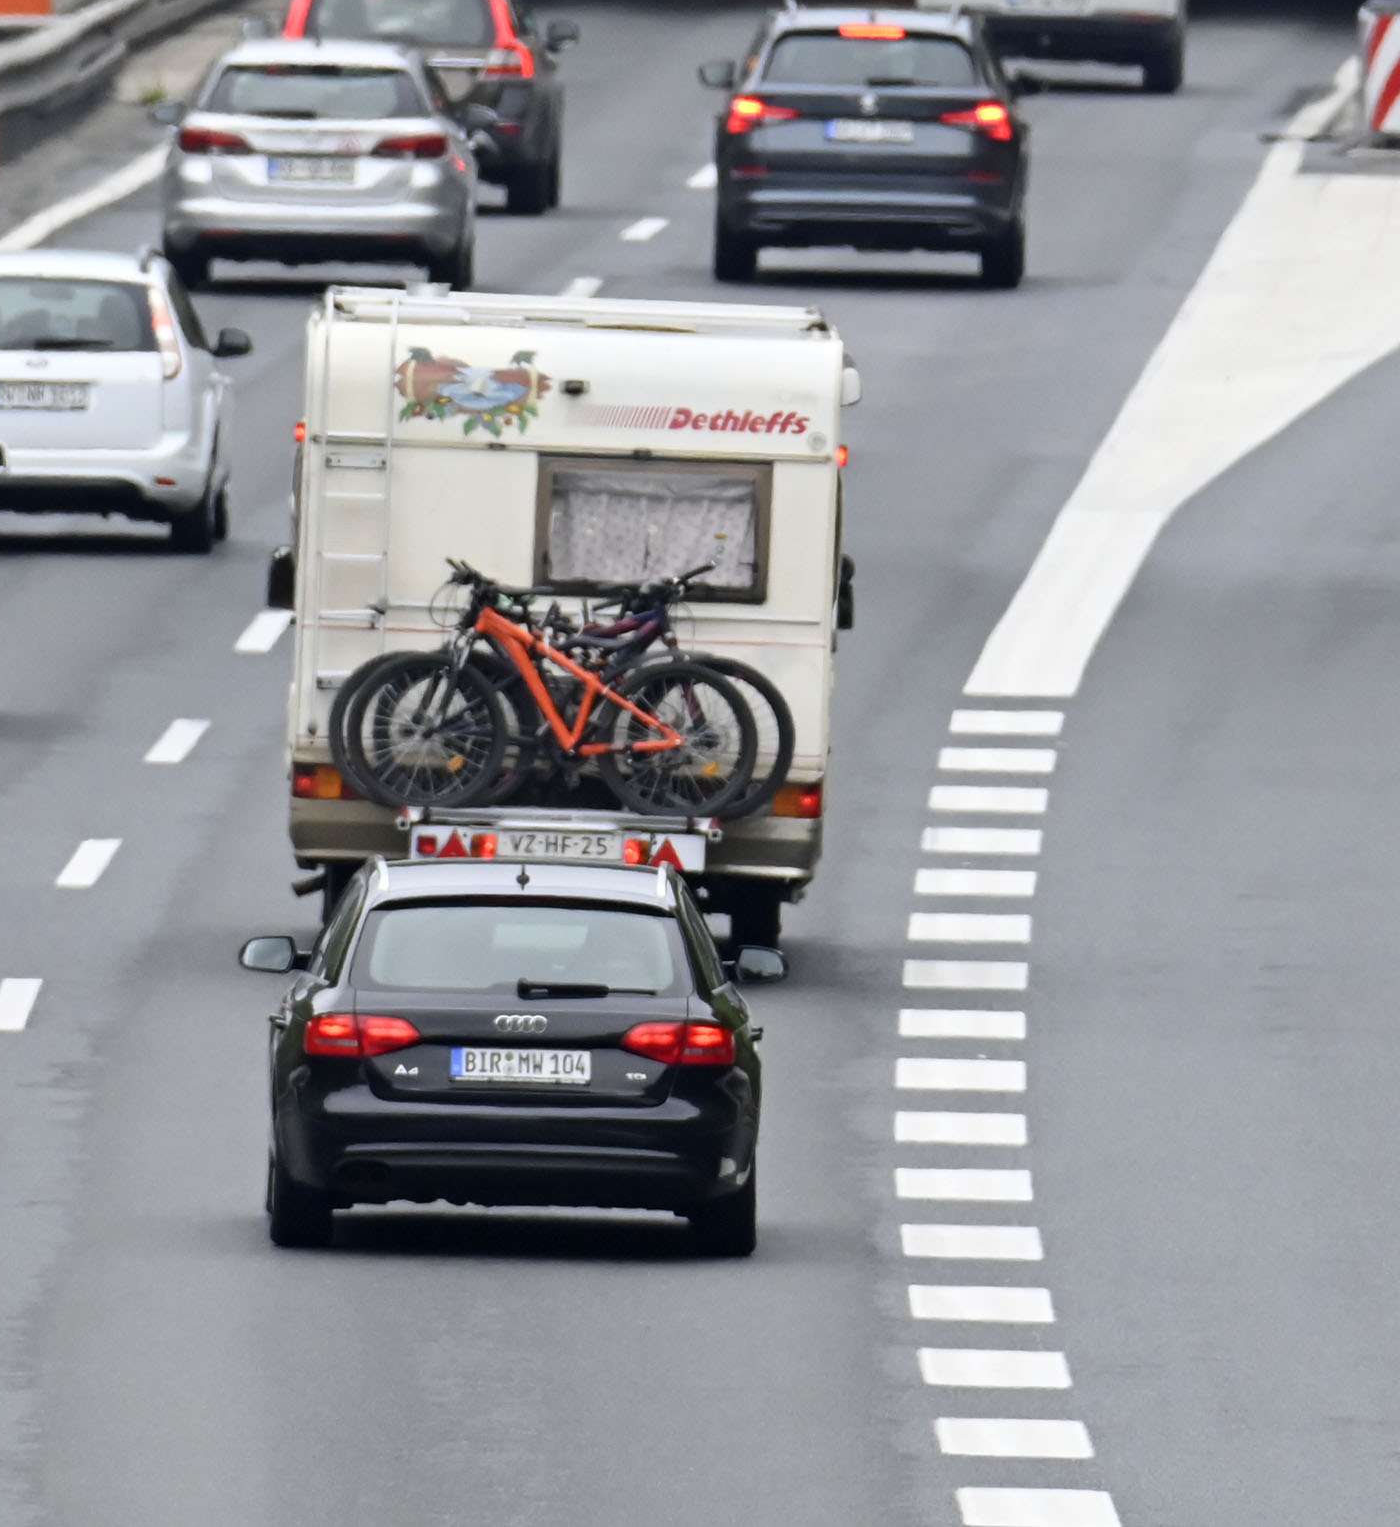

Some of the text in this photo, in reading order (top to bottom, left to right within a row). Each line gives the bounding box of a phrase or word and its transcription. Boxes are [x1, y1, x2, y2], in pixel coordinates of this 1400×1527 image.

[668, 406, 811, 436] Dethleffs
[464, 1049, 587, 1077] BIR MW 104
